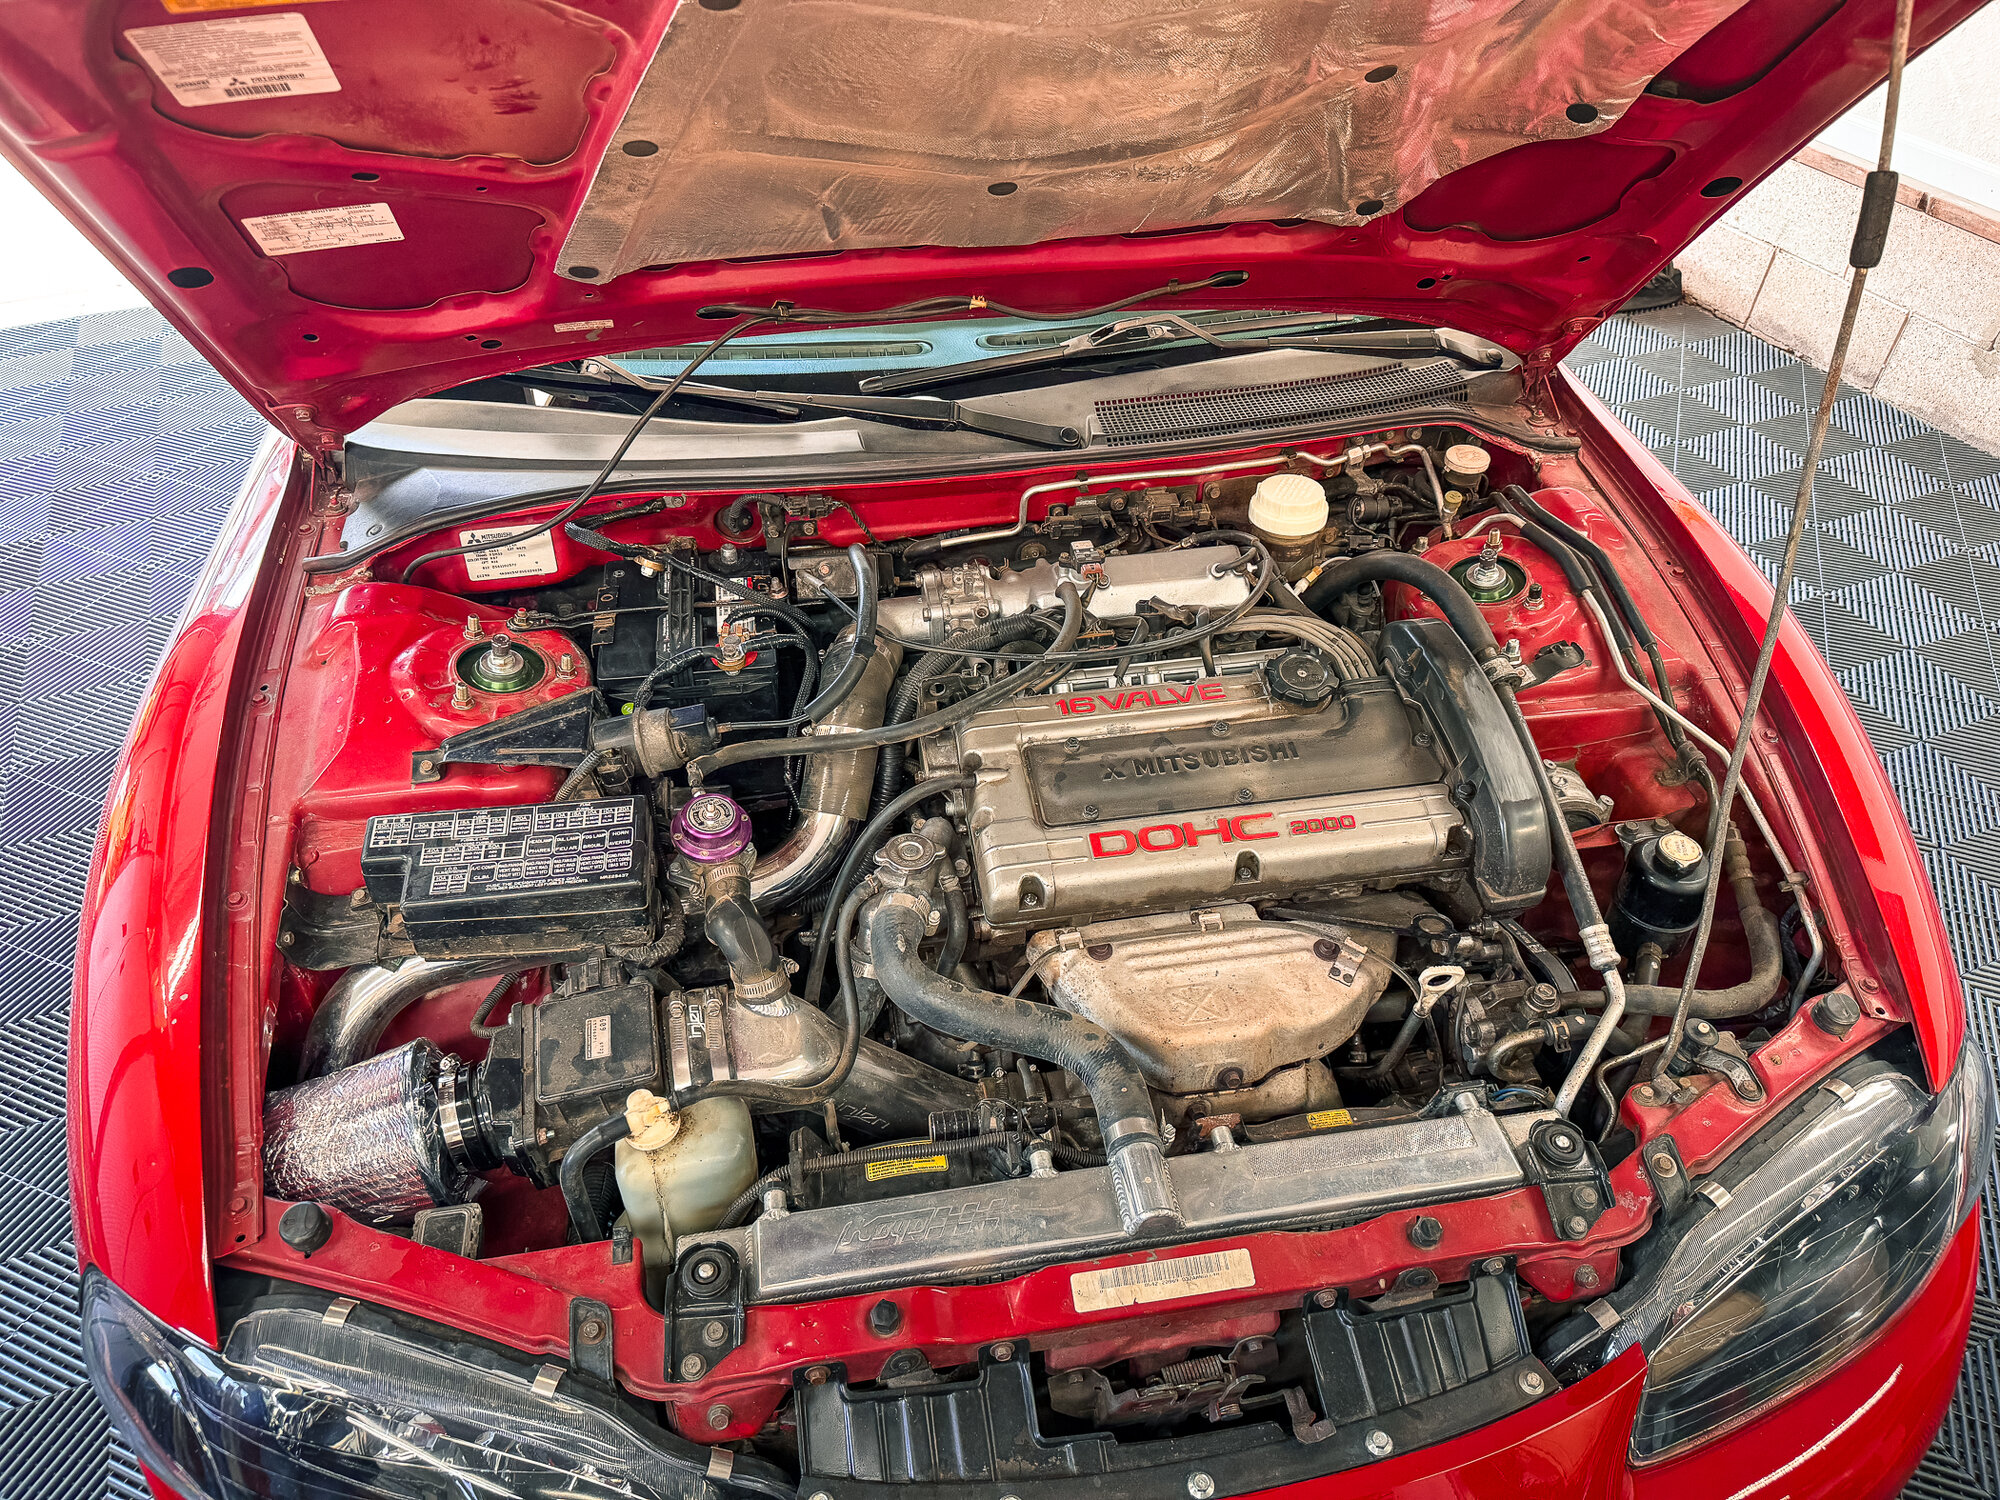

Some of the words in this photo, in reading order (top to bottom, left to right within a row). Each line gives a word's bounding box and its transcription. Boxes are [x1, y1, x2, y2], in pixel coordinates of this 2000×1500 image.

[481, 532, 512, 541] MITSUBISHI
[1132, 741, 1300, 776] MITSUBISHI
[1088, 812, 1280, 859] DOHC
[1290, 815, 1357, 836] 2000
